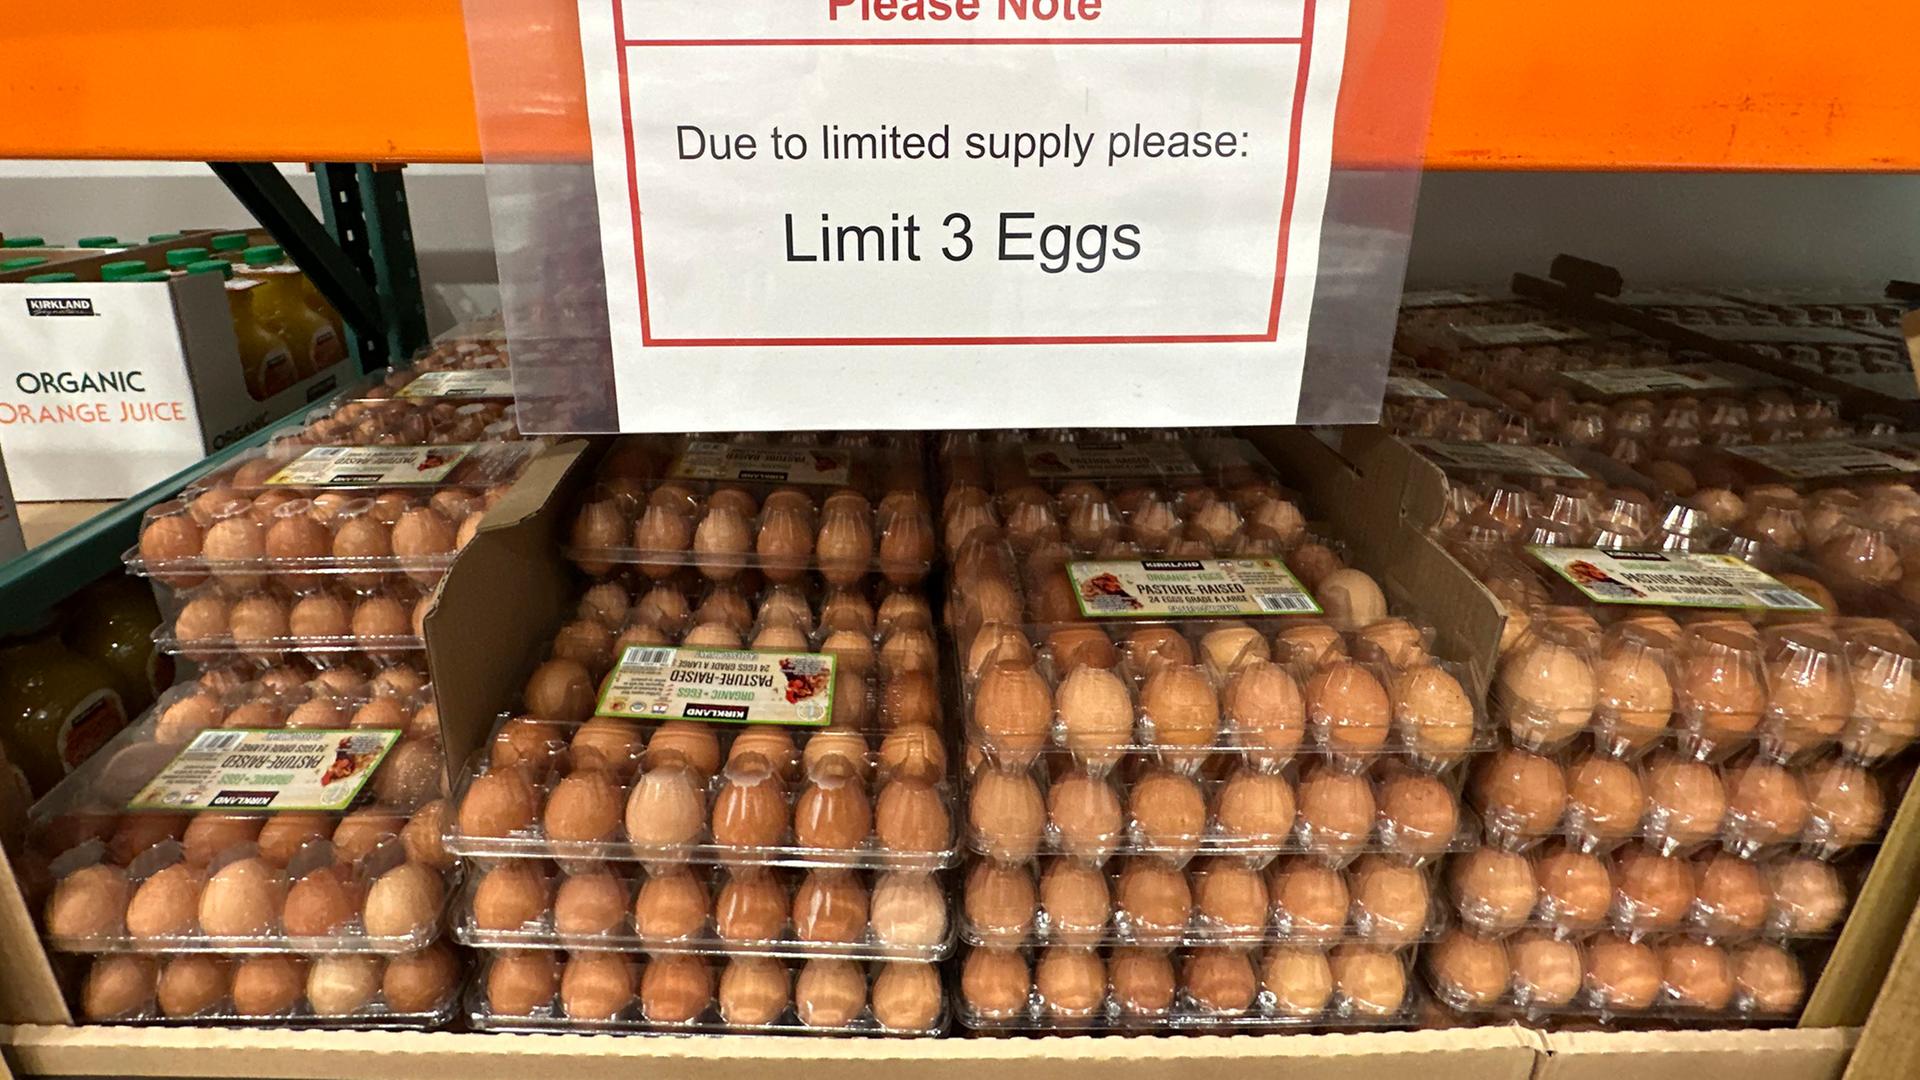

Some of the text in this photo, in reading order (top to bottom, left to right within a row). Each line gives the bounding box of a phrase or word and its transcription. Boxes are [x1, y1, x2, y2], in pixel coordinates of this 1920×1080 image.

[829, 0, 1102, 21] Please Note
[677, 123, 1248, 168] Due to limited supply please:
[785, 212, 1141, 274] Limit 3 Eggs
[30, 300, 90, 309] KIRKLAND
[16, 371, 145, 394] ORGANIC
[0, 400, 187, 424] ORANGE JUICE
[1136, 583, 1246, 595] PASTURE-RAISED
[679, 659, 703, 669] LARGE
[711, 661, 736, 671] GRADE
[737, 663, 758, 672] EGGS
[760, 664, 770, 672] 24
[670, 669, 774, 687] PASTURE-RAISED
[677, 687, 755, 701] ORGANIC EGGS
[686, 708, 745, 718] KIRKLAND
[221, 754, 325, 769] PASTURE-RAISED
[213, 796, 271, 805] KIRKLAND
